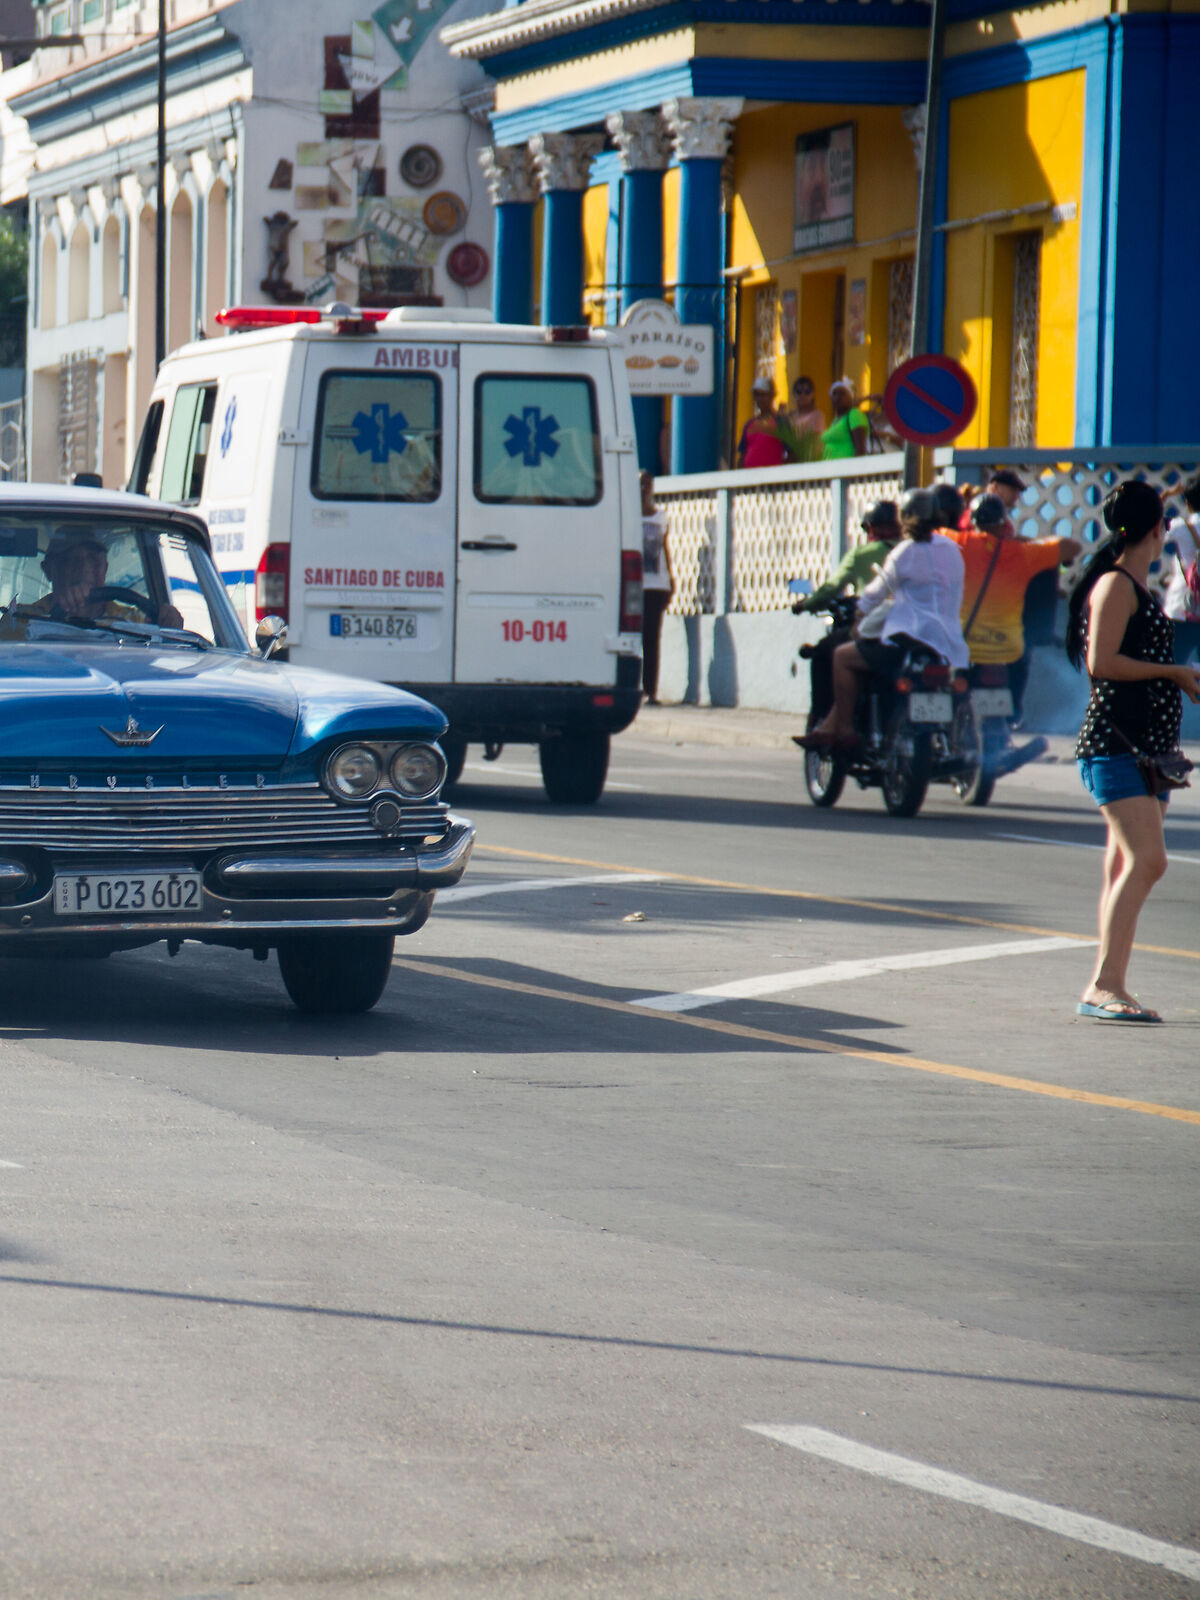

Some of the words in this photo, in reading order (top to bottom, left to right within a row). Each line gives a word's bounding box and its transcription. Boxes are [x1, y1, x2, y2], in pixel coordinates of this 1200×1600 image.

[304, 568, 378, 587] SANTIAGO
[382, 569, 401, 588] DE
[405, 570, 445, 588] CUBA
[341, 616, 352, 635] B
[500, 619, 568, 643] 10-014
[75, 881, 91, 910] P
